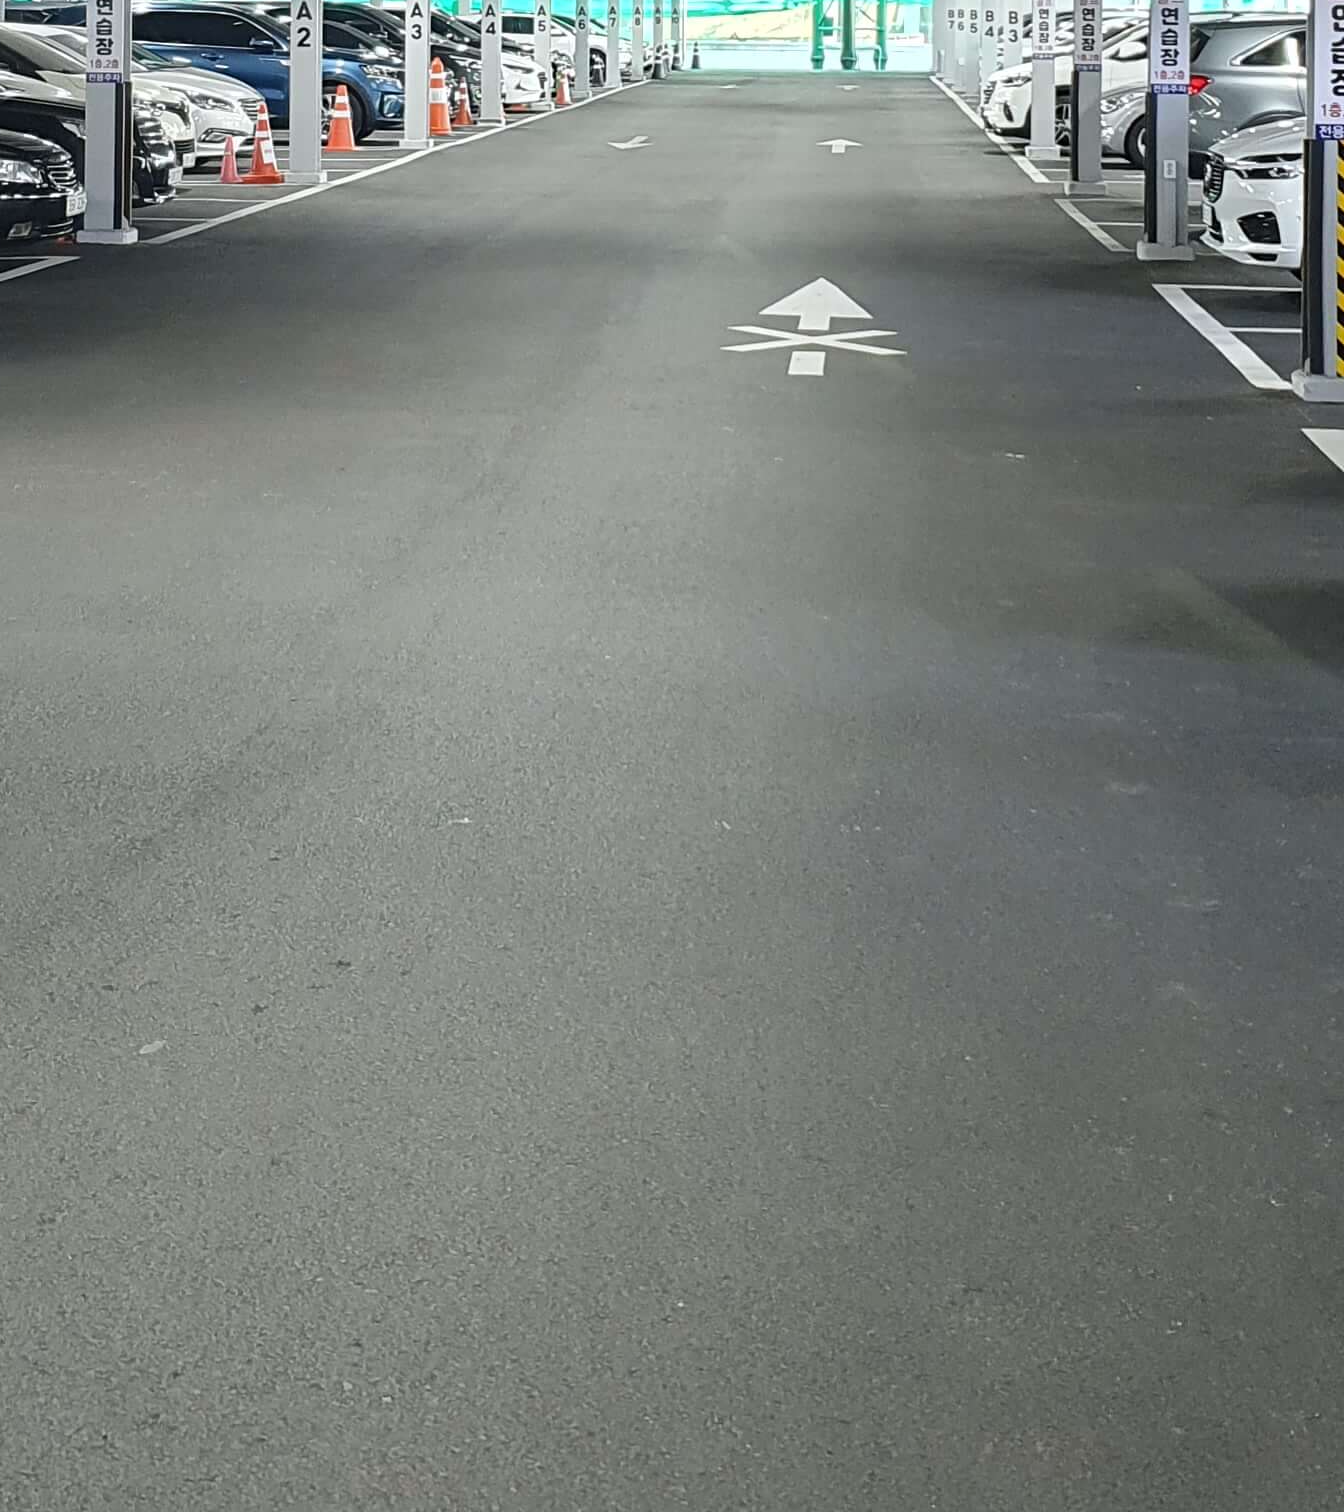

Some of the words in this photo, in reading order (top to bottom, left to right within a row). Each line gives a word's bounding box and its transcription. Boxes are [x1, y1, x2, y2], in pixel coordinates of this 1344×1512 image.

[295, 1, 313, 21] A
[410, 2, 424, 18] A
[1009, 11, 1018, 24] B
[297, 28, 311, 48] 2
[411, 24, 422, 40] 3
[1008, 29, 1017, 42] 3
[1160, 6, 1180, 66] 연습장
